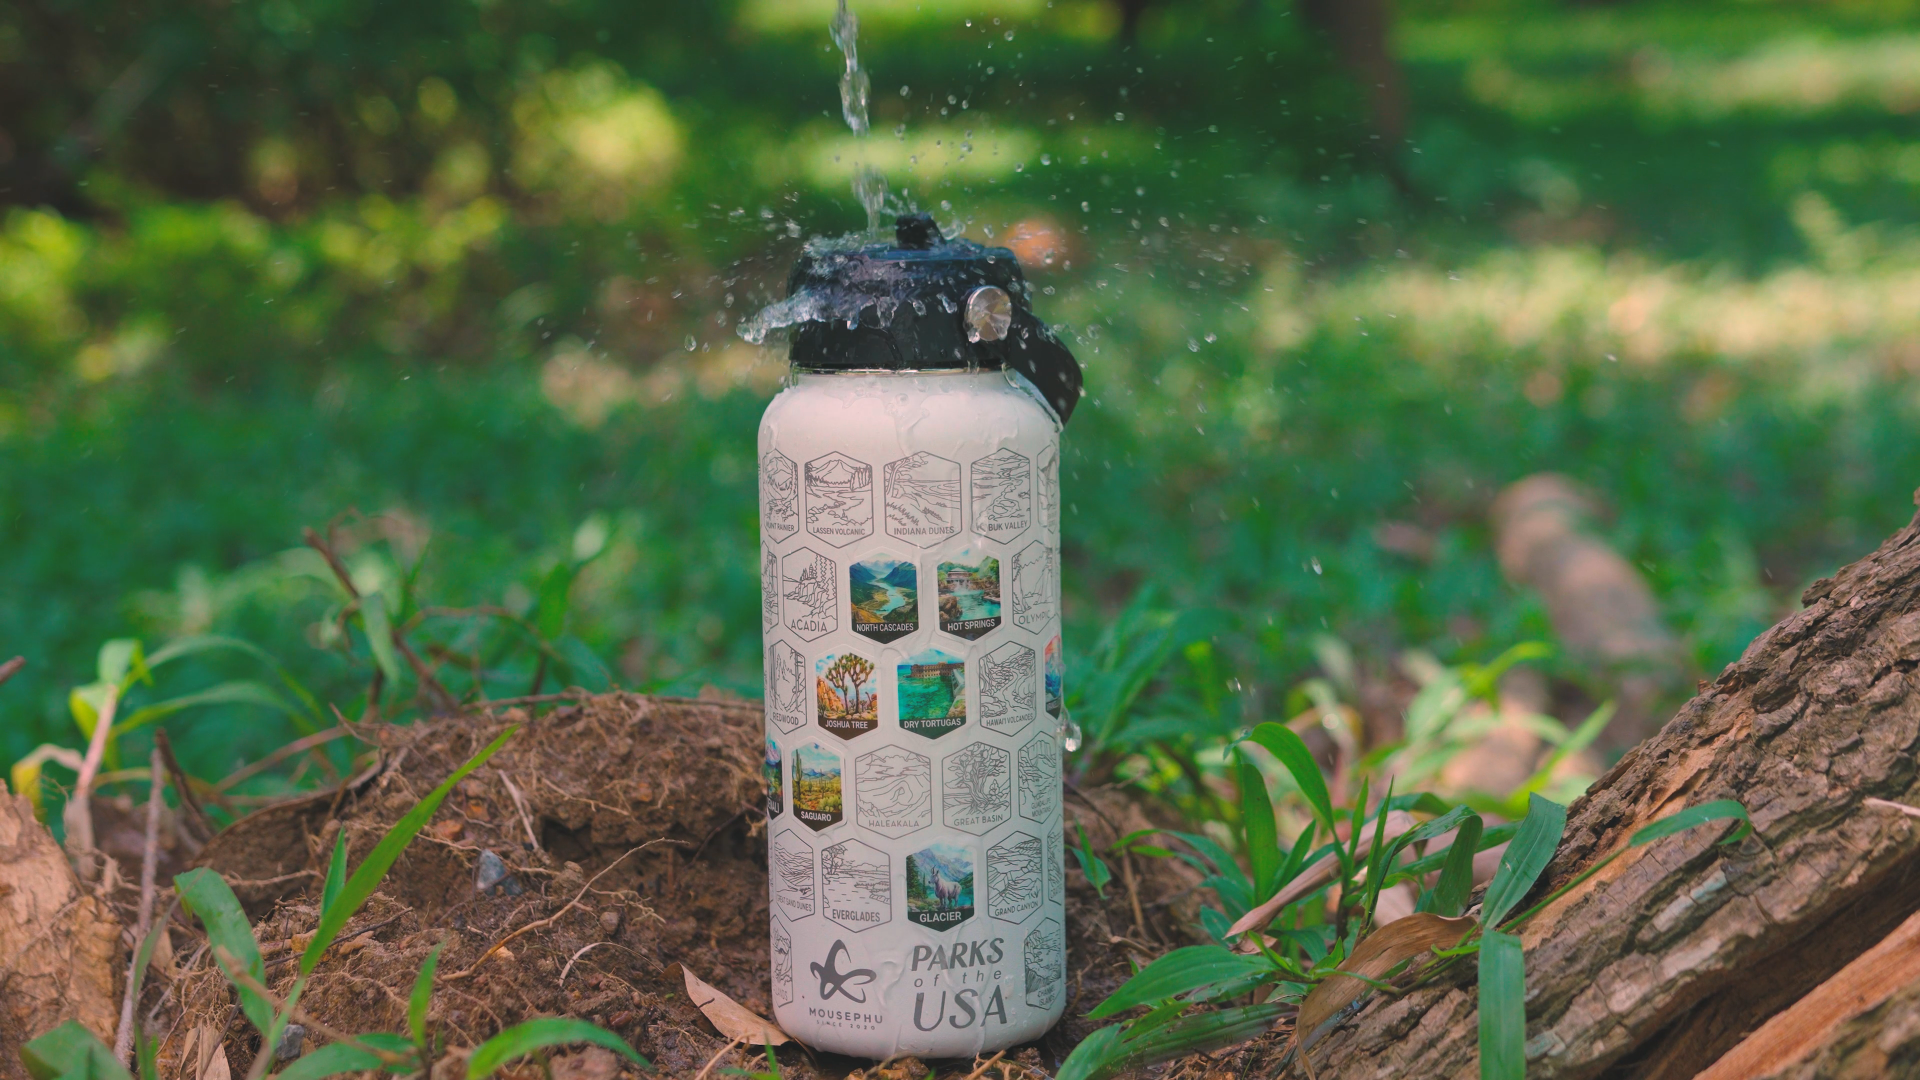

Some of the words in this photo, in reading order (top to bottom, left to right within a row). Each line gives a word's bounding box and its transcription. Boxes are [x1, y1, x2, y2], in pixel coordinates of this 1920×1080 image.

[812, 527, 835, 535] LASSEN
[835, 528, 866, 536] VOLCANIC
[893, 527, 927, 535] INDIANA
[928, 526, 955, 535] DUNES
[976, 522, 1003, 532] KBUK
[1004, 520, 1029, 530] VALLEY
[791, 618, 828, 633] ACADIA
[856, 623, 879, 632] NORTH
[879, 623, 914, 632] CASCADES
[947, 621, 963, 631] HOT
[964, 619, 996, 630] SPRINGS
[772, 711, 800, 726] REDWOOD
[825, 720, 851, 729] JOSHUA
[851, 721, 868, 729] TREE
[904, 720, 920, 729] DRY
[920, 718, 962, 728] TORTUGAS
[1007, 713, 1034, 725] VOLCANOES
[767, 800, 780, 814] ENALI
[800, 811, 832, 822] SAGUARO
[953, 817, 980, 826] GREAT
[981, 814, 1004, 824] BASIN
[869, 820, 920, 828] HALEAKALA
[786, 899, 797, 907] SAND
[797, 901, 812, 912] DUNES
[995, 906, 1016, 916] GRAND
[1016, 901, 1039, 911] CANYON
[832, 909, 880, 922] EVERGLADES
[919, 911, 962, 923] GLACIER
[911, 937, 1005, 972] PARKS
[914, 973, 940, 987] of
[962, 970, 1002, 984] the
[913, 984, 1008, 1032] USA
[809, 1007, 883, 1024] MOUSEPHU
[816, 1020, 842, 1028] SINCE
